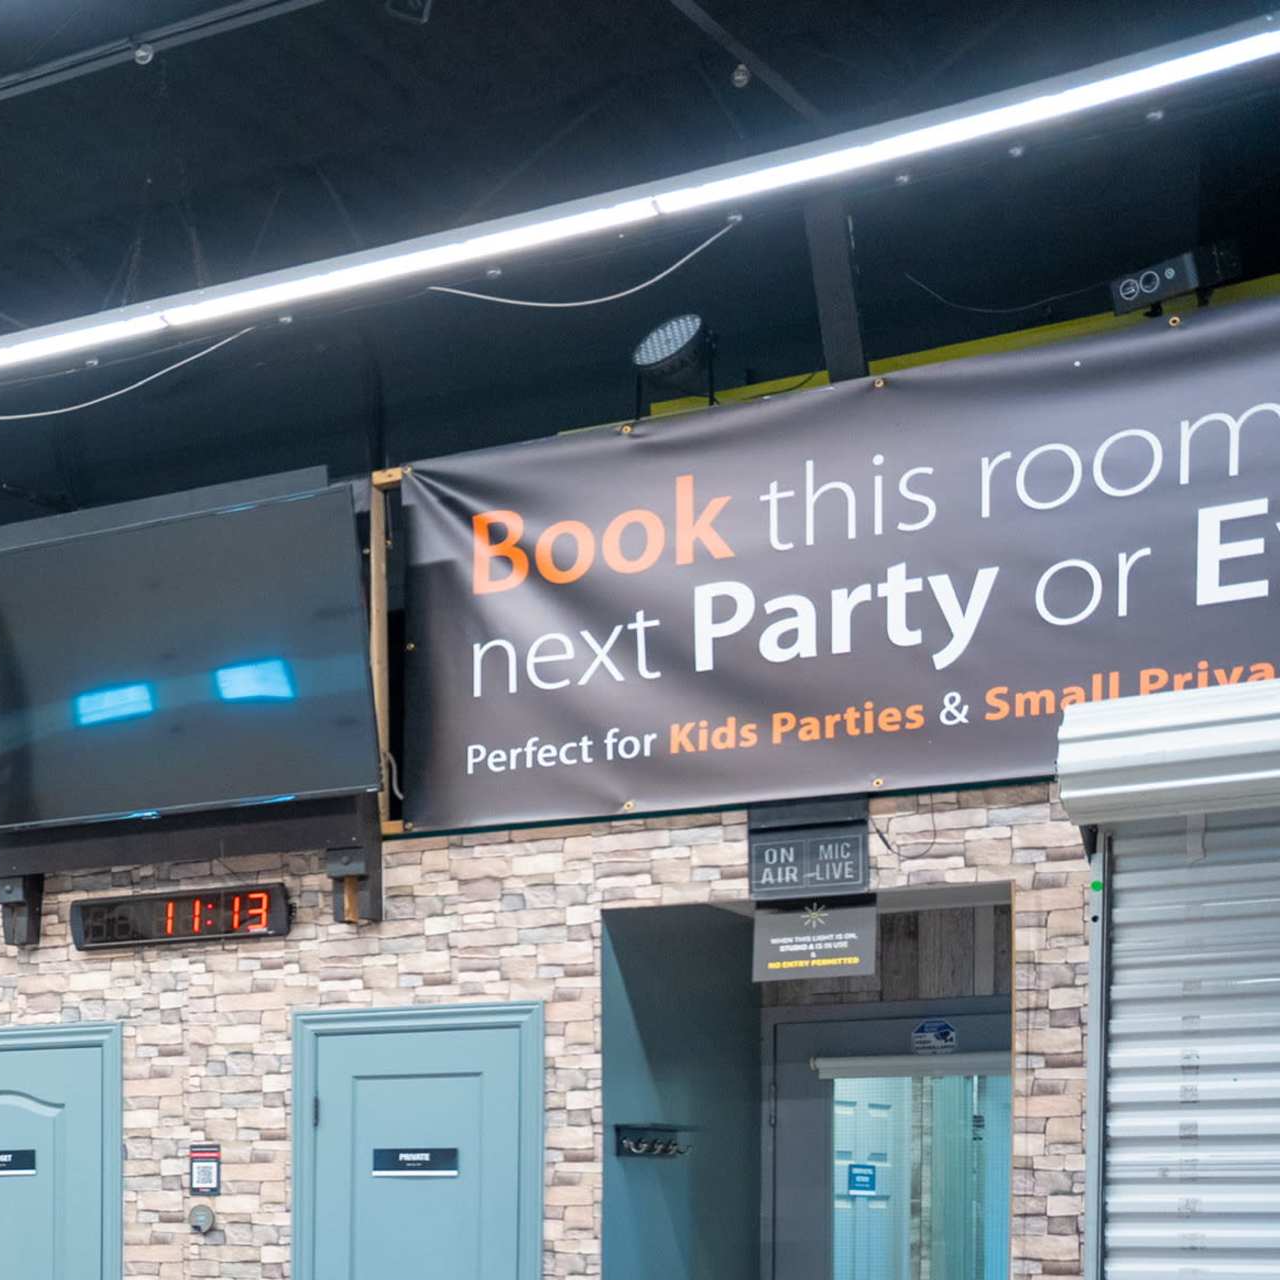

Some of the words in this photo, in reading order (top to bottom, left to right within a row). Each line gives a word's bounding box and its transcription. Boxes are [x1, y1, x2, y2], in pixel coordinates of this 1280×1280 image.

[472, 474, 736, 595] Book
[759, 454, 937, 551] this
[981, 403, 1280, 518] room
[473, 609, 661, 698] next
[694, 562, 999, 671] Party
[1035, 547, 1151, 626] or
[1196, 498, 1280, 606] E
[467, 735, 593, 775] Perfect
[605, 728, 657, 761] for
[669, 717, 757, 754] Kids
[772, 702, 925, 744] Parties
[939, 691, 969, 726] &
[984, 671, 1120, 721] Small
[764, 847, 795, 865] ON
[819, 842, 851, 861] MIC
[761, 866, 799, 885] AIR
[815, 861, 854, 881] LIVE
[164, 892, 269, 935] 11:13
